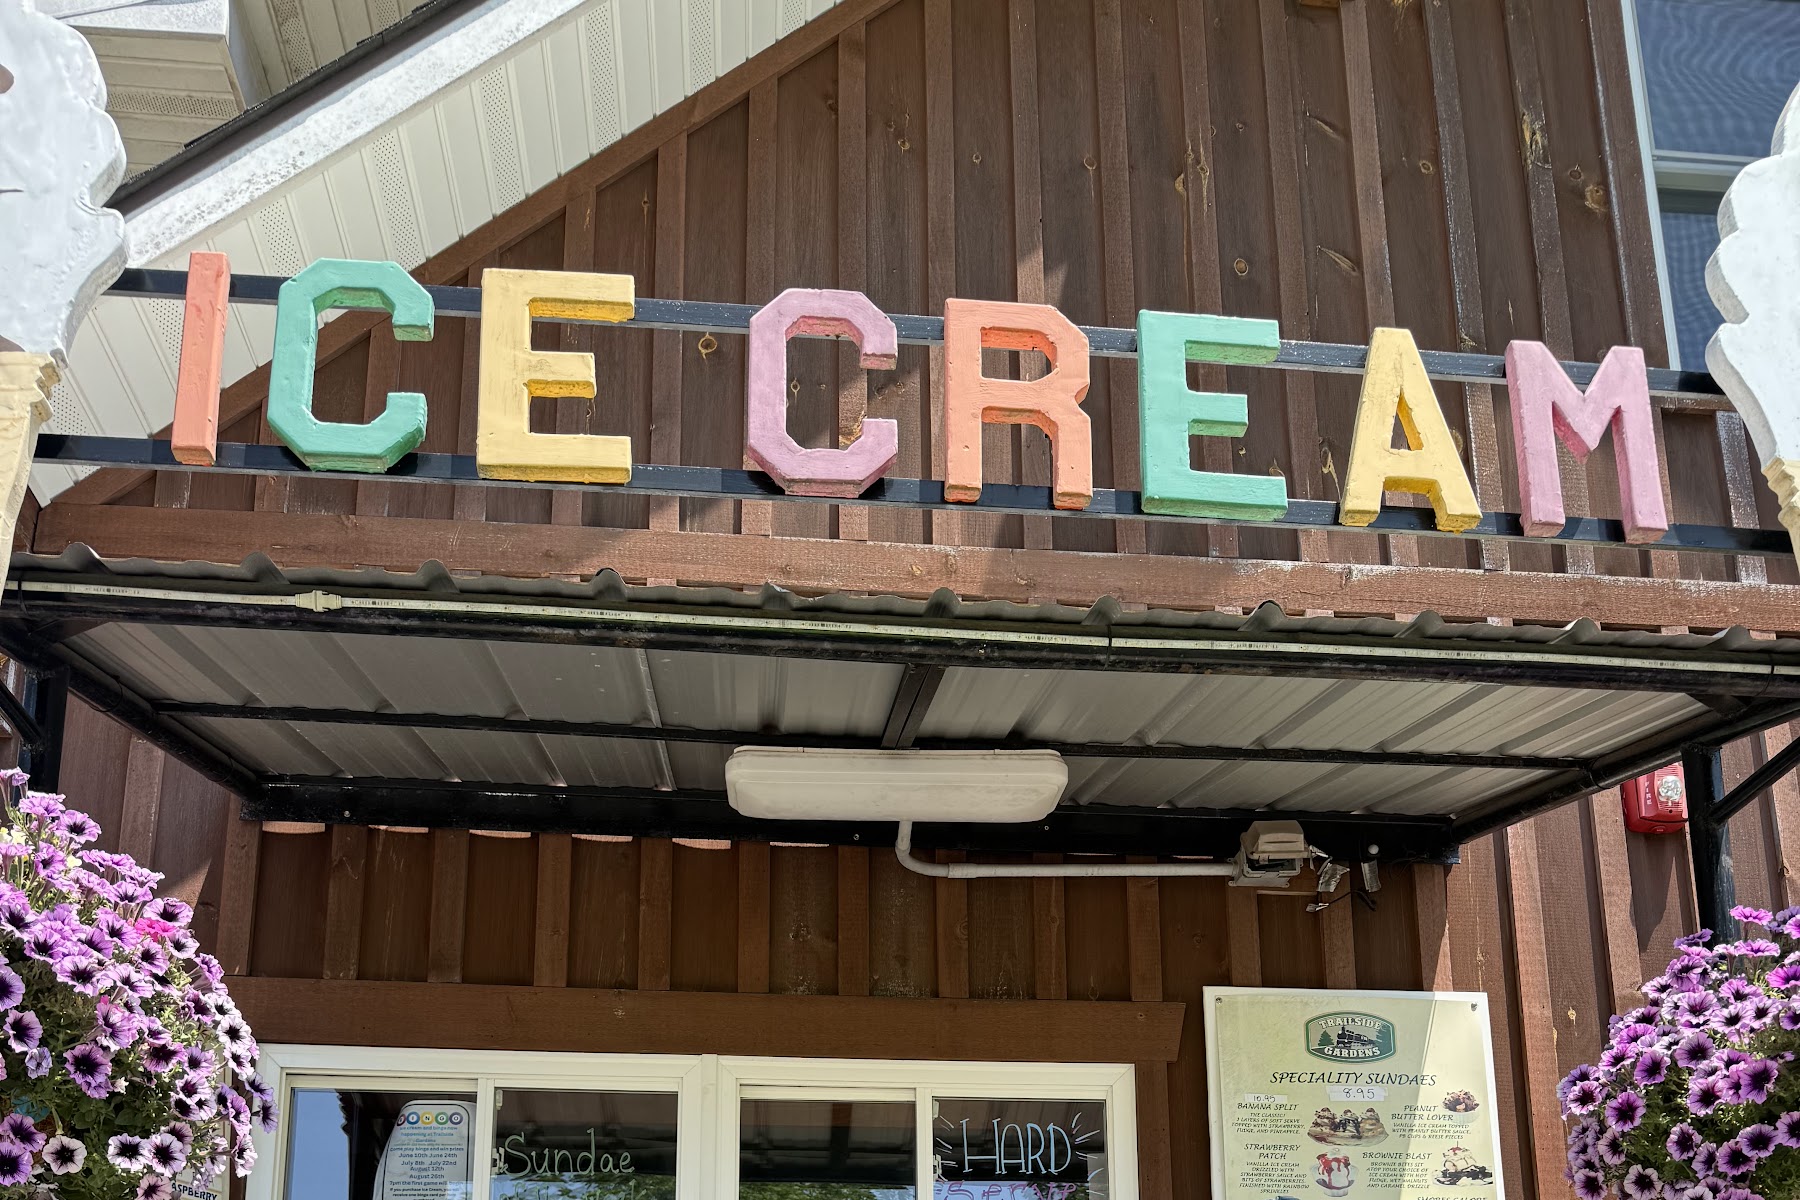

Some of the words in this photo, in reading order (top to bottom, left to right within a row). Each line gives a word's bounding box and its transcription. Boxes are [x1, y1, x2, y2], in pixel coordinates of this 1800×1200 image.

[171, 251, 636, 484] ICE
[747, 288, 1668, 544] CREAM
[1318, 1018, 1382, 1030] TRAILSIDE
[1324, 1046, 1380, 1058] GARDENS
[1270, 1072, 1362, 1085] SPECIALITY
[1366, 1073, 1437, 1086] SUNDAES
[1343, 1088, 1376, 1100] 8.95
[504, 1128, 635, 1177] Sundae
[960, 1118, 1072, 1175] HARD
